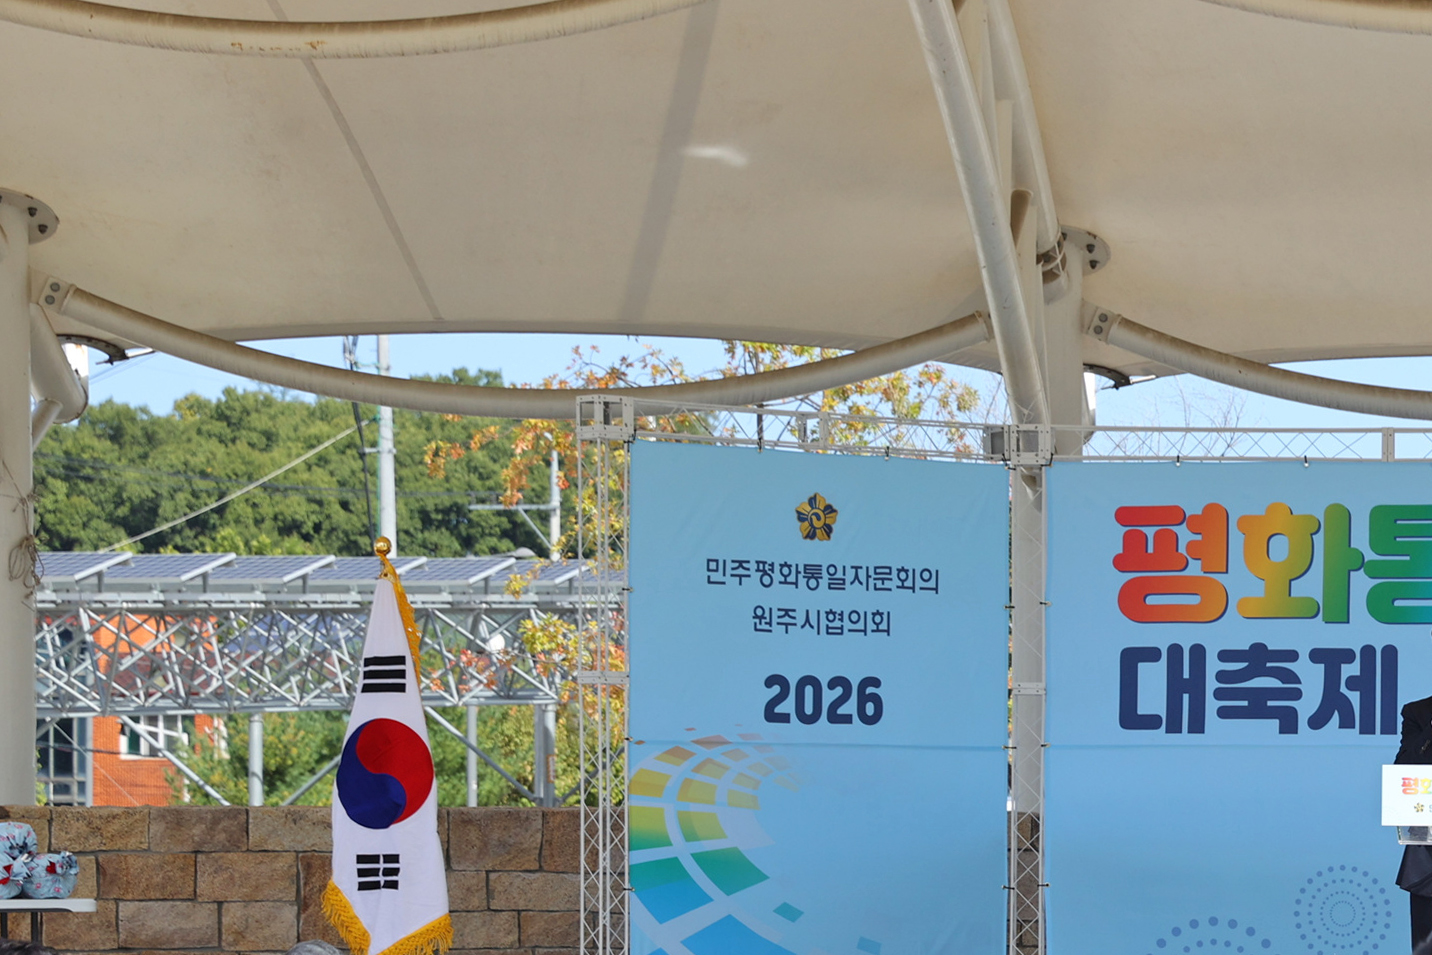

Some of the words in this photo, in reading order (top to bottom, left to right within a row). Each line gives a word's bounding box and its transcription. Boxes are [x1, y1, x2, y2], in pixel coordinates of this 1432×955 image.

[706, 558, 940, 595] 민주평화통일자문회의
[752, 605, 892, 636] 원주시협의회
[763, 674, 884, 725] 2026
[1118, 642, 1399, 735] 대축제
